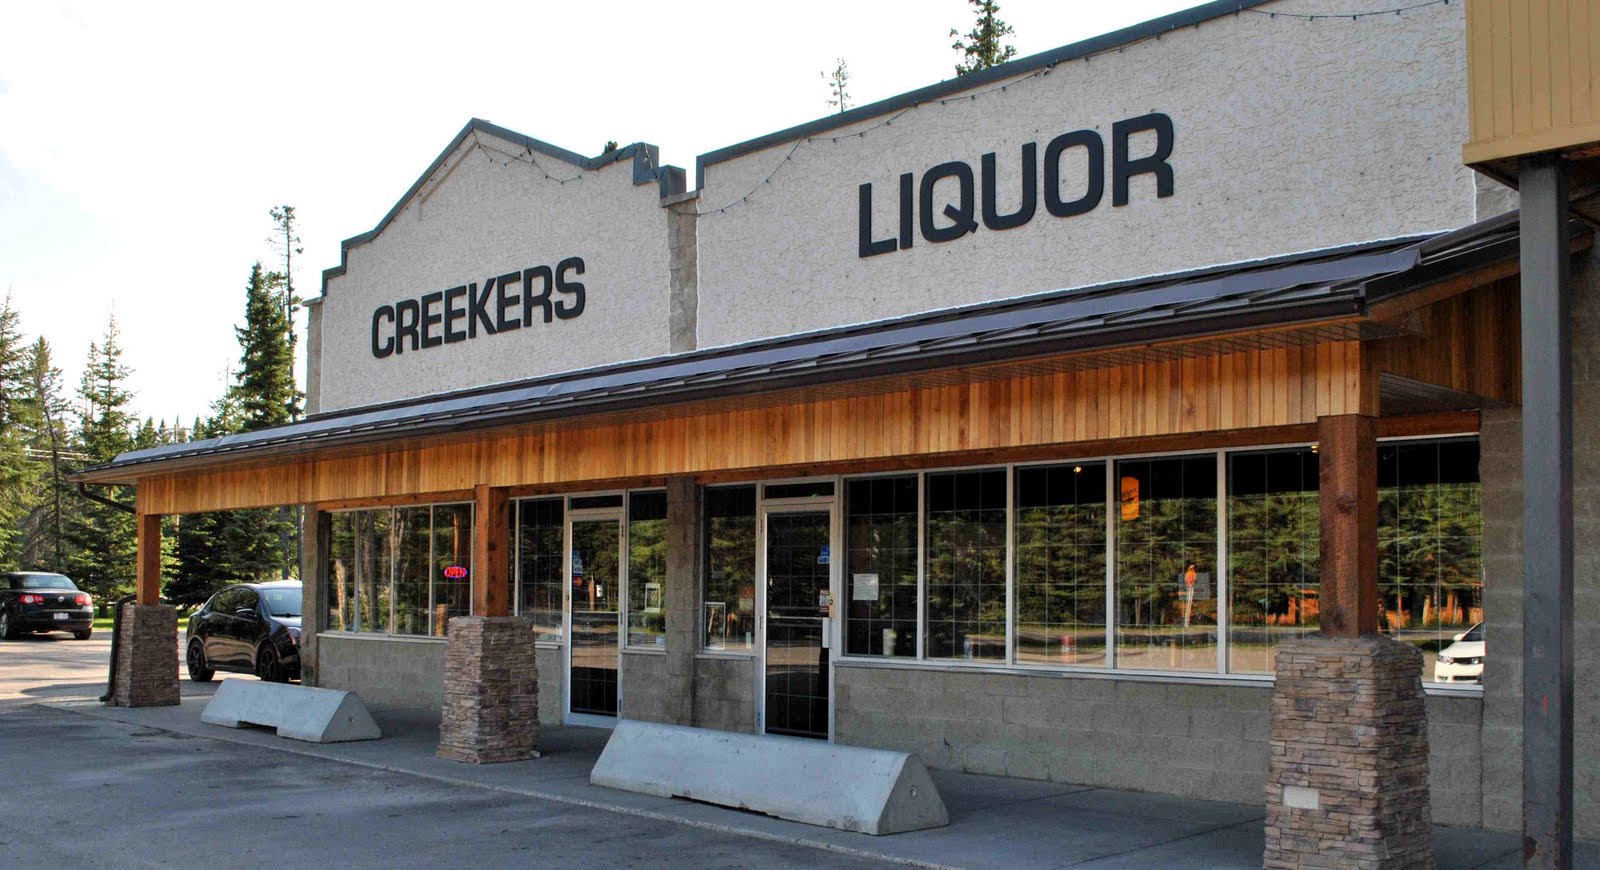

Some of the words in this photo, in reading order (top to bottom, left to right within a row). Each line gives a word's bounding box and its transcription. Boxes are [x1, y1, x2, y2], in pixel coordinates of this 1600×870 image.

[859, 113, 1174, 258] LIQUOR
[372, 257, 585, 358] CREEKERS
[445, 566, 467, 578] OPEN
